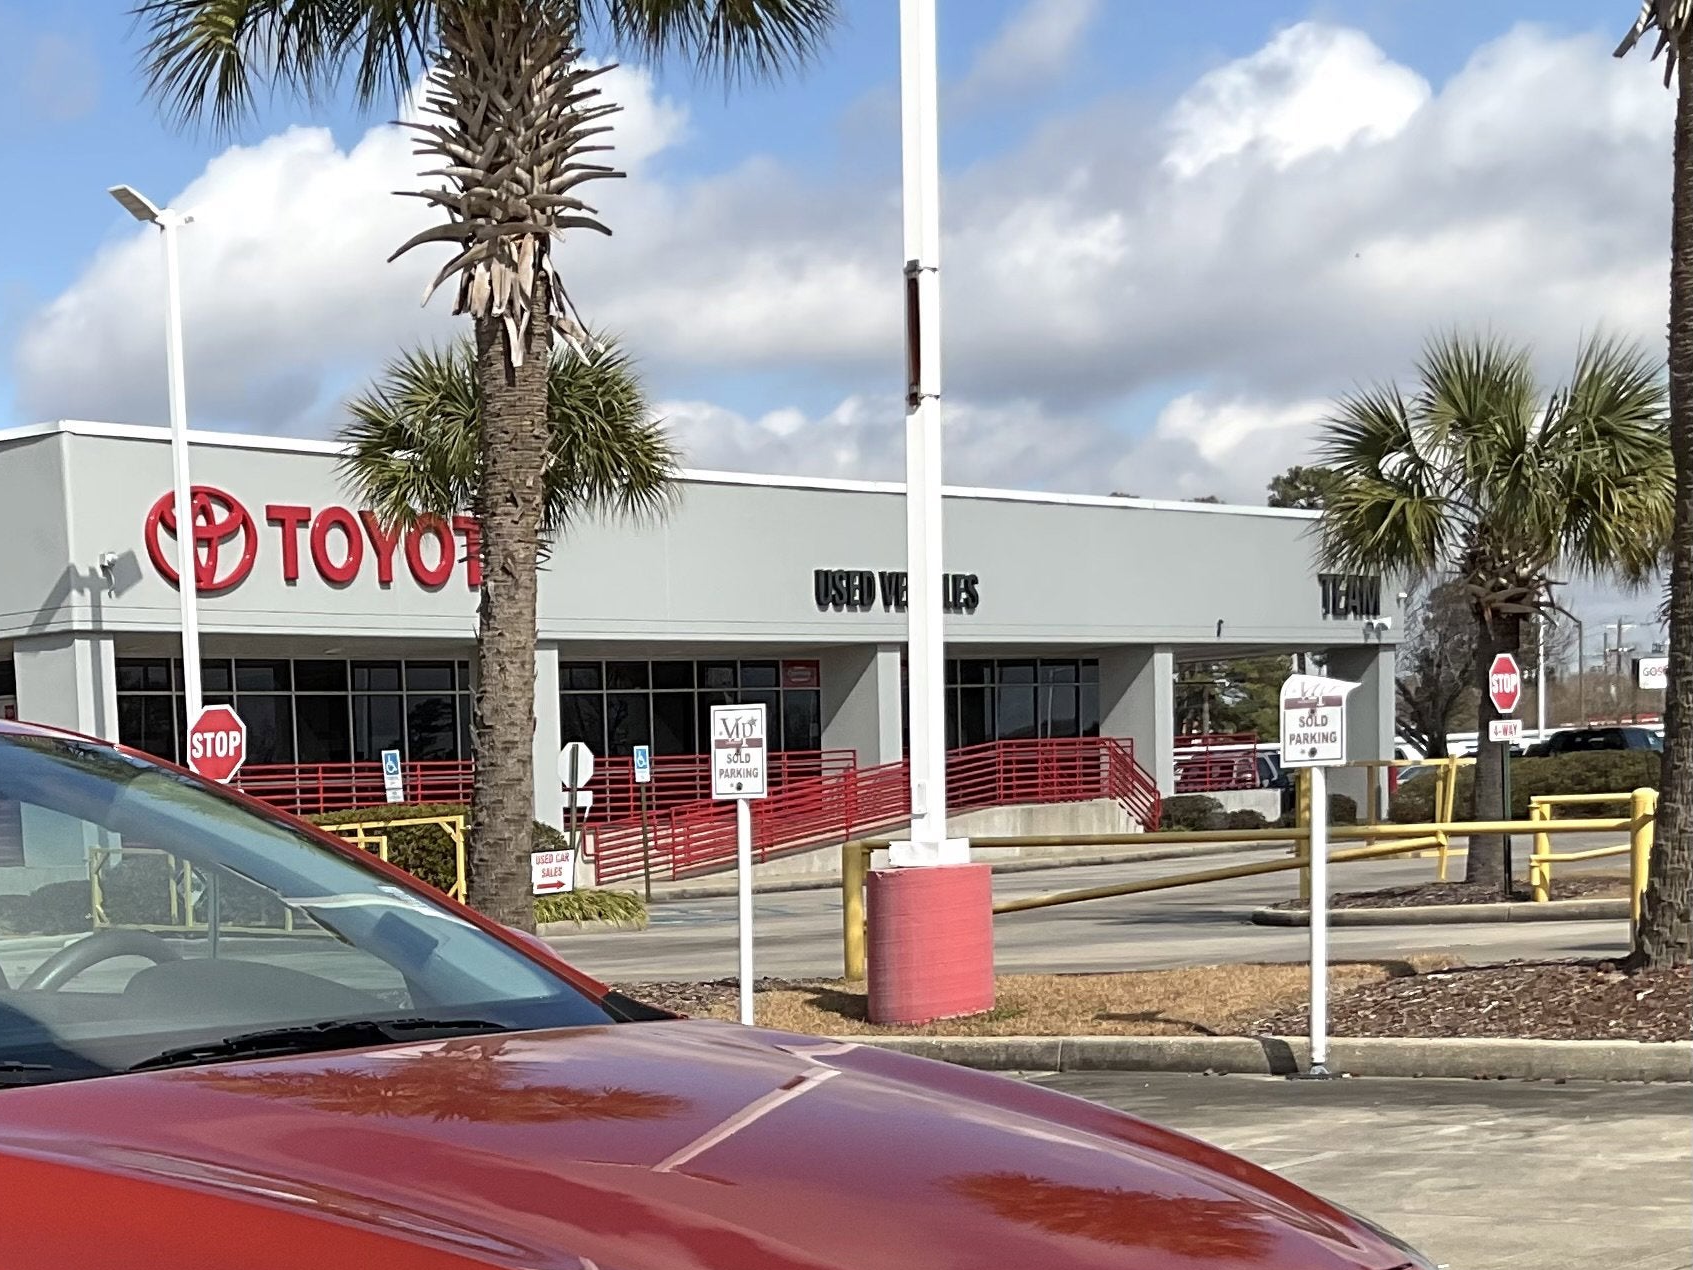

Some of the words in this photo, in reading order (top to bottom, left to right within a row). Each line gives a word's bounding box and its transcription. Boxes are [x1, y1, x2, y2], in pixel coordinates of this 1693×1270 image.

[266, 504, 483, 587] TOYOT
[814, 569, 875, 607] USED
[878, 571, 980, 609] VELES
[1318, 574, 1381, 615] TEAM
[1492, 673, 1517, 694] STOP
[1299, 715, 1328, 728] SOLD
[191, 730, 241, 759] STOP
[1289, 731, 1337, 746] PARKING
[726, 753, 751, 764] SOLD
[719, 768, 759, 779] PARKING
[536, 854, 554, 865] USED
[556, 852, 570, 863] CAR
[541, 866, 563, 878] SALES
